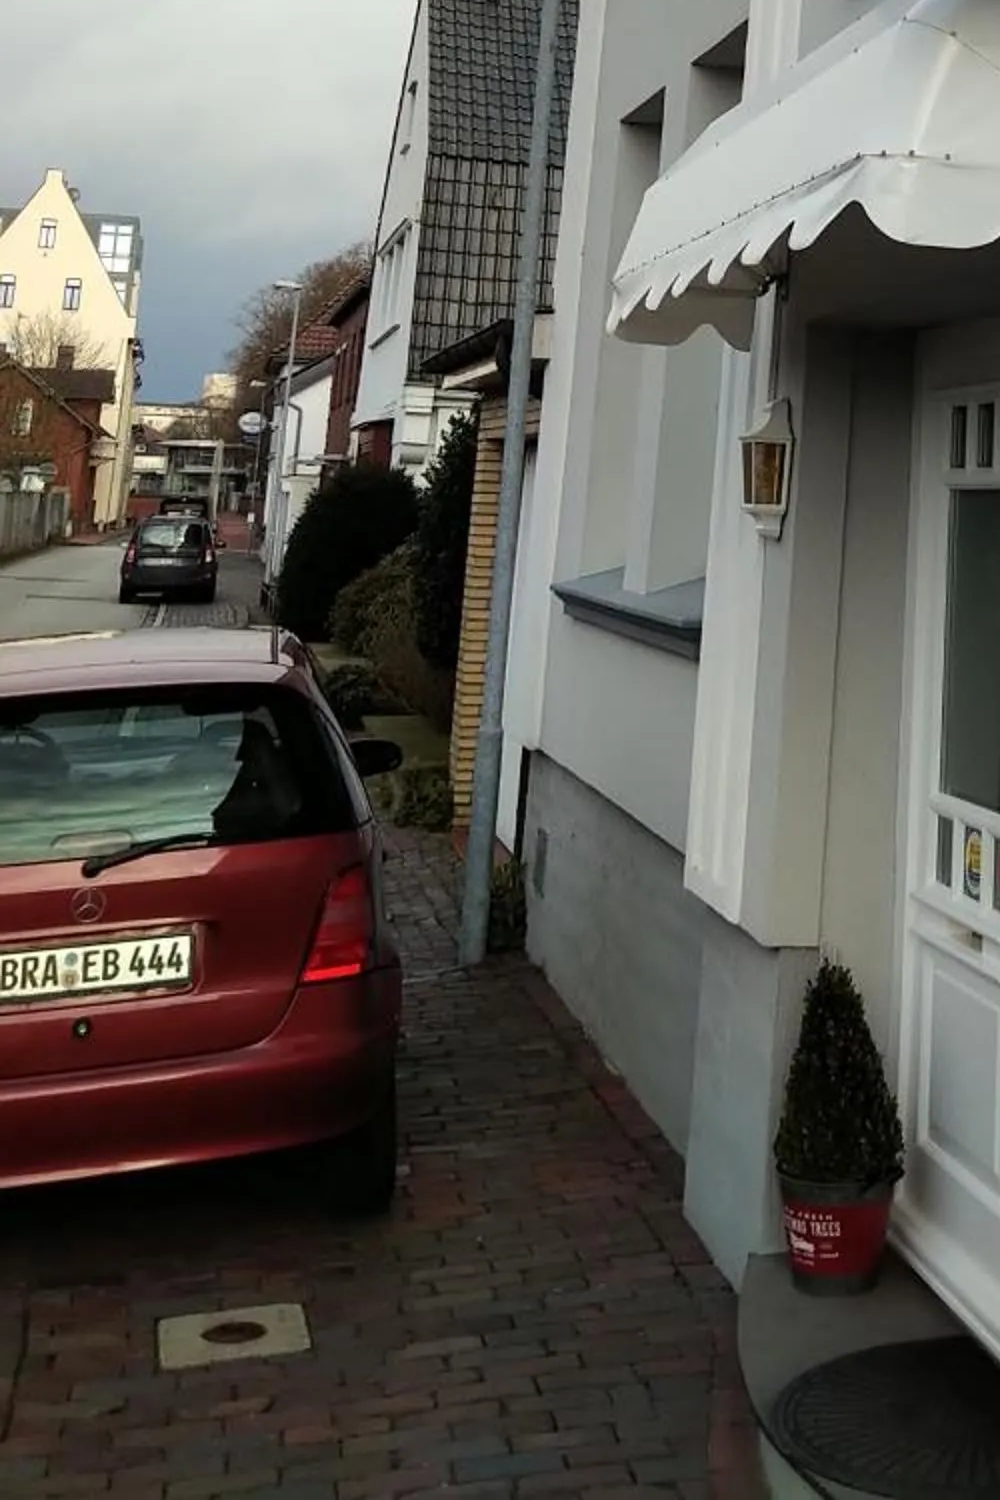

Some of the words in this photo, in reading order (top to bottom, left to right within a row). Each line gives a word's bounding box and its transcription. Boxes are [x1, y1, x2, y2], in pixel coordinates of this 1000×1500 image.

[1, 954, 59, 990] BRA
[82, 949, 120, 983] EB
[129, 941, 183, 977] 444
